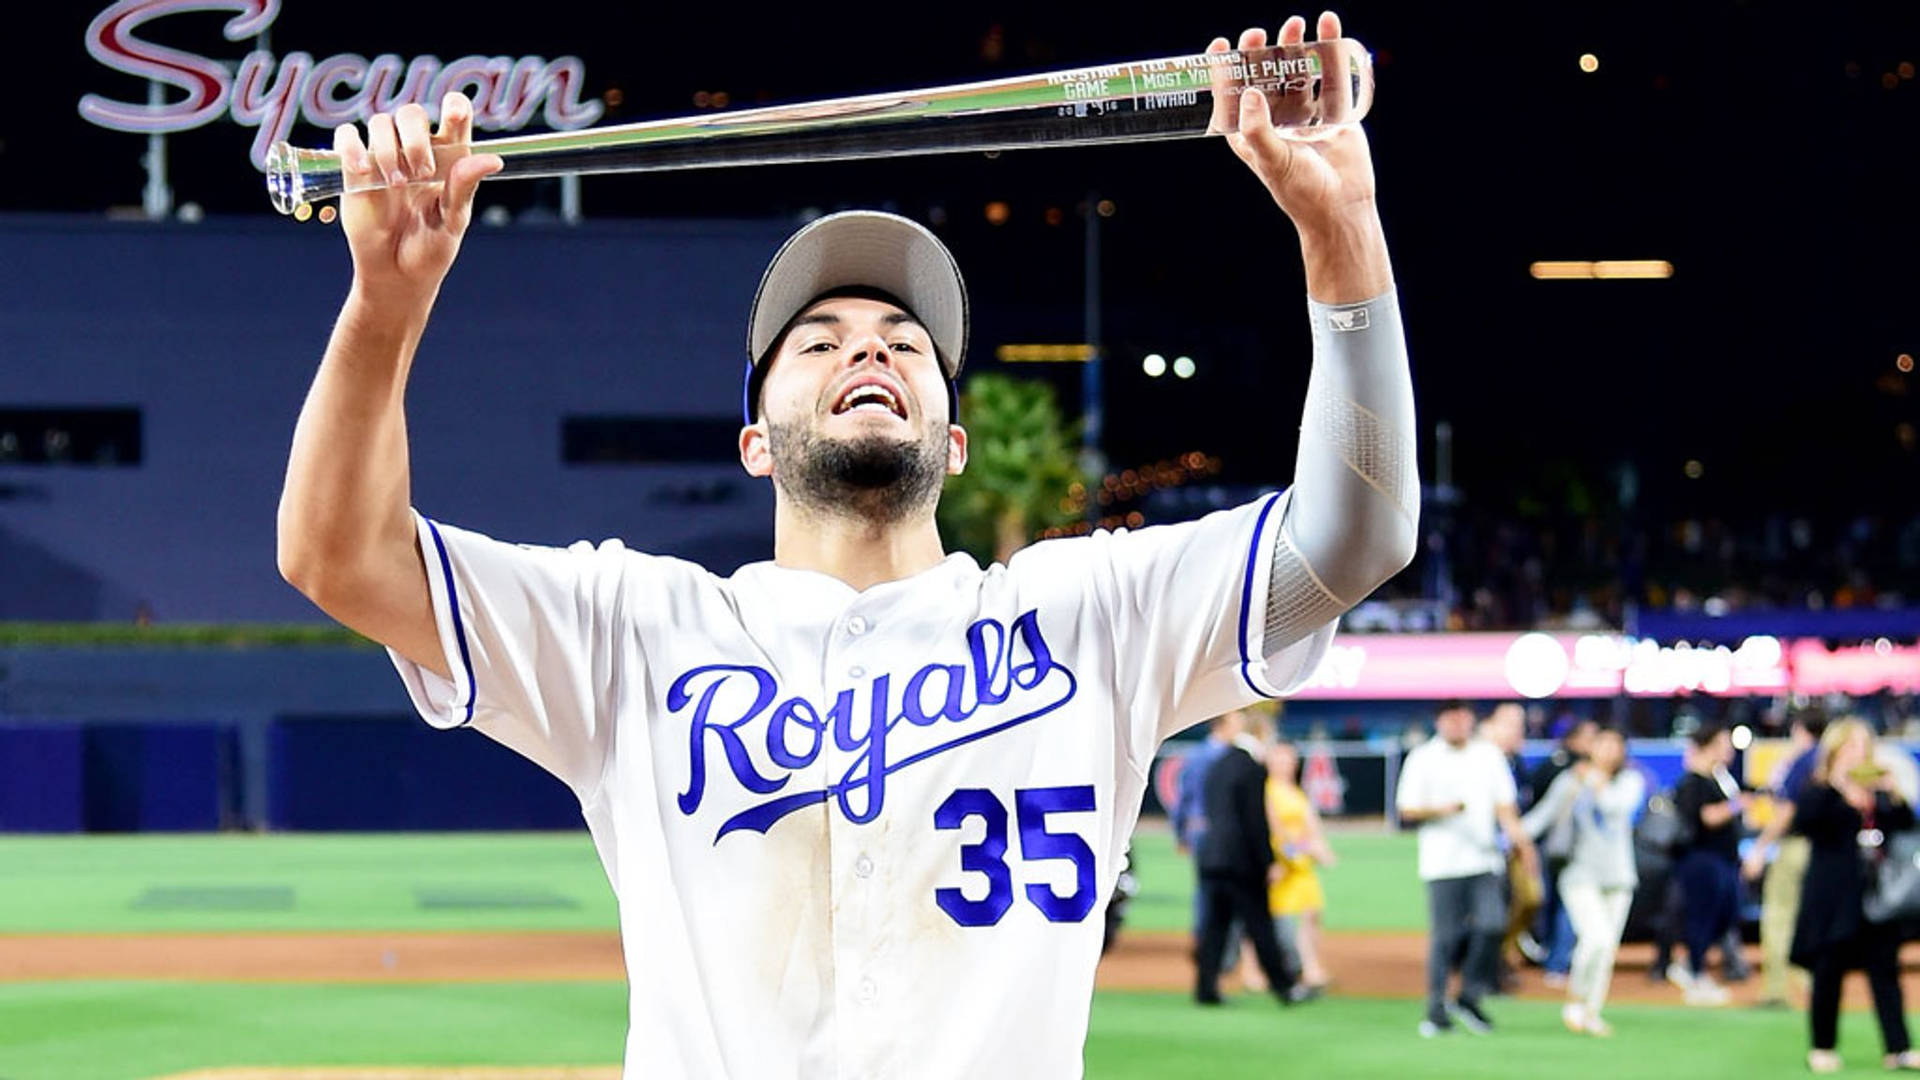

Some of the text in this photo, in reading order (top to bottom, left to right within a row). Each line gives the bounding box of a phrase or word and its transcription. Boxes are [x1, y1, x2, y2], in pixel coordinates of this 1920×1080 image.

[78, 0, 602, 170] Sycuan
[1064, 79, 1109, 100] GAME
[1142, 57, 1314, 89] MOST VALABLE PLAYER
[1145, 91, 1197, 110] AWARD
[666, 608, 1077, 844] Royals
[934, 785, 1096, 927] 35
